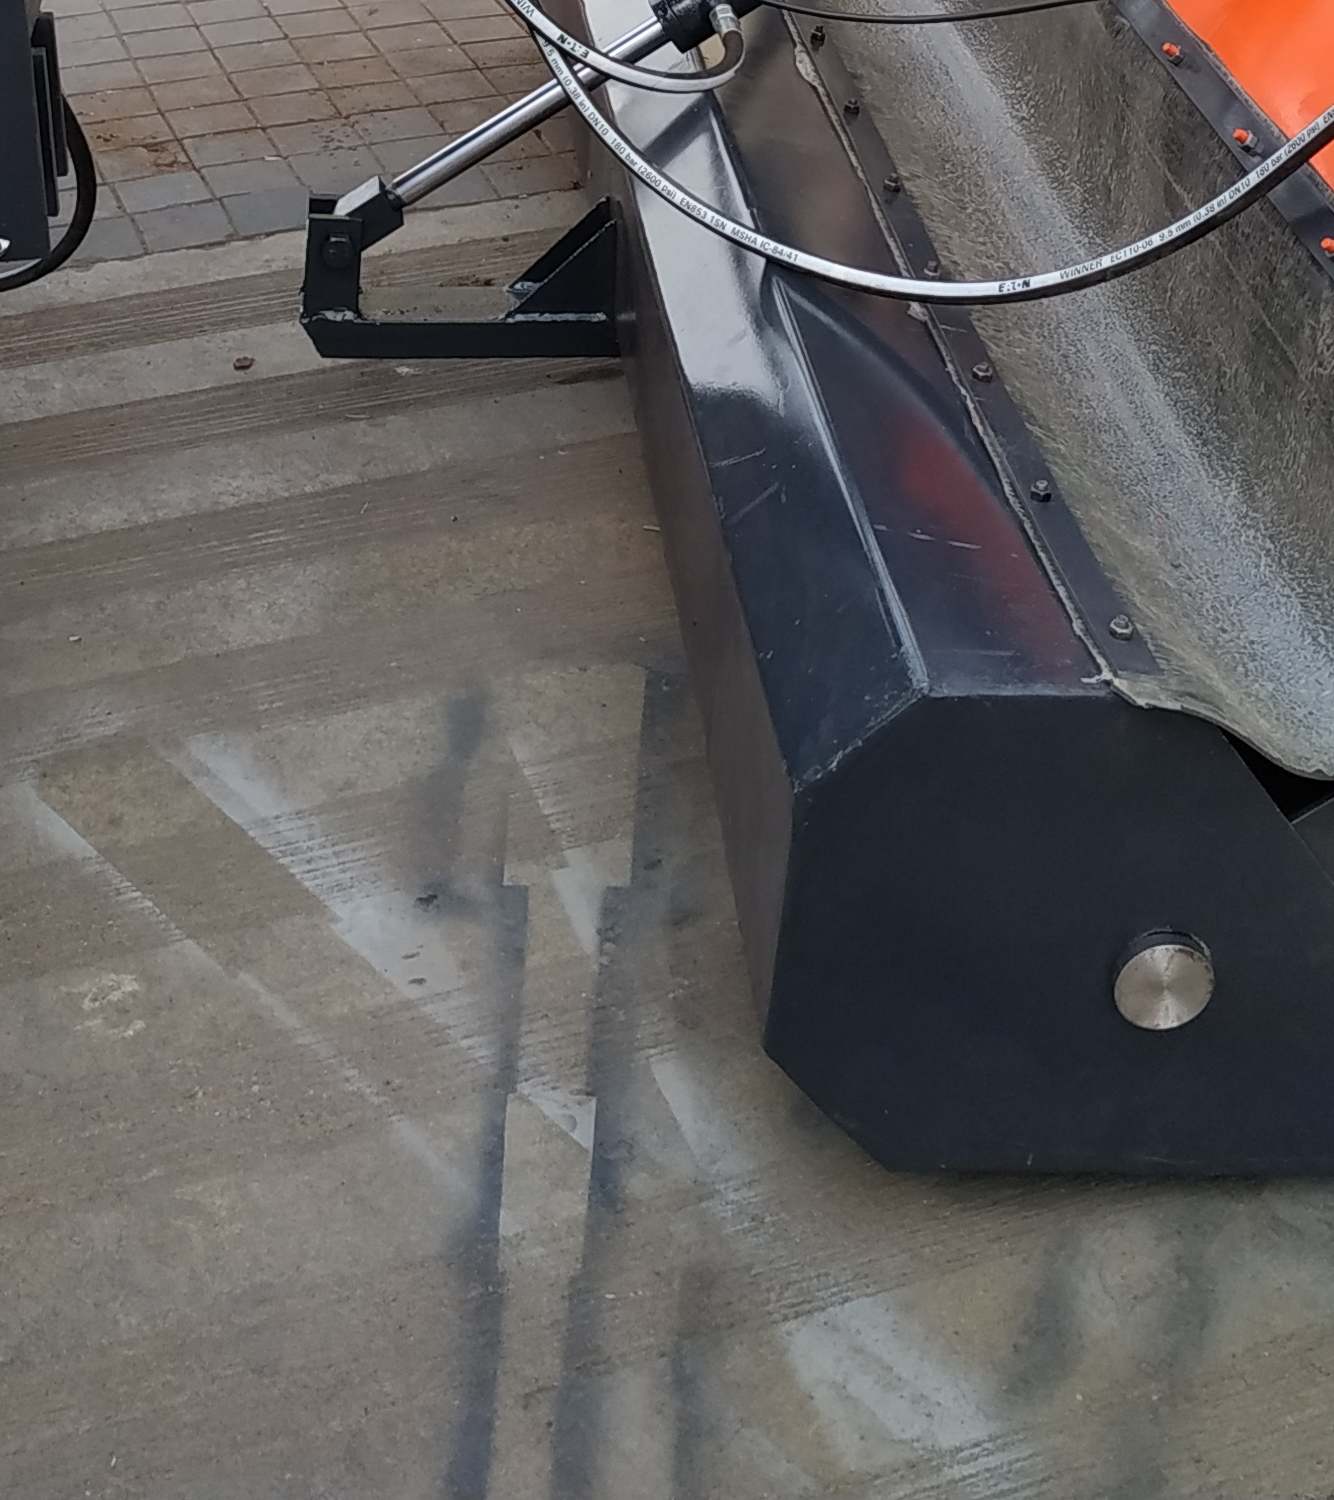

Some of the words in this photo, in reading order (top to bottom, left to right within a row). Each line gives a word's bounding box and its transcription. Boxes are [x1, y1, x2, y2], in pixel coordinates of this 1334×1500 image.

[551, 57, 565, 76] mm
[587, 111, 610, 136] DN10
[610, 136, 627, 156] 180
[624, 150, 639, 168] bar
[637, 163, 662, 189] (2600
[660, 184, 678, 200] psi)
[679, 197, 708, 220] EN853
[709, 215, 727, 231] 1SN
[730, 226, 758, 247] MSHA
[759, 239, 799, 263] IC-84/41
[1059, 257, 1103, 280] WINNER
[1109, 237, 1154, 264] EC110-06
[1174, 219, 1192, 233] mm
[1228, 178, 1251, 200] DN10
[1255, 163, 1270, 180] 180
[1270, 152, 1283, 168] bar
